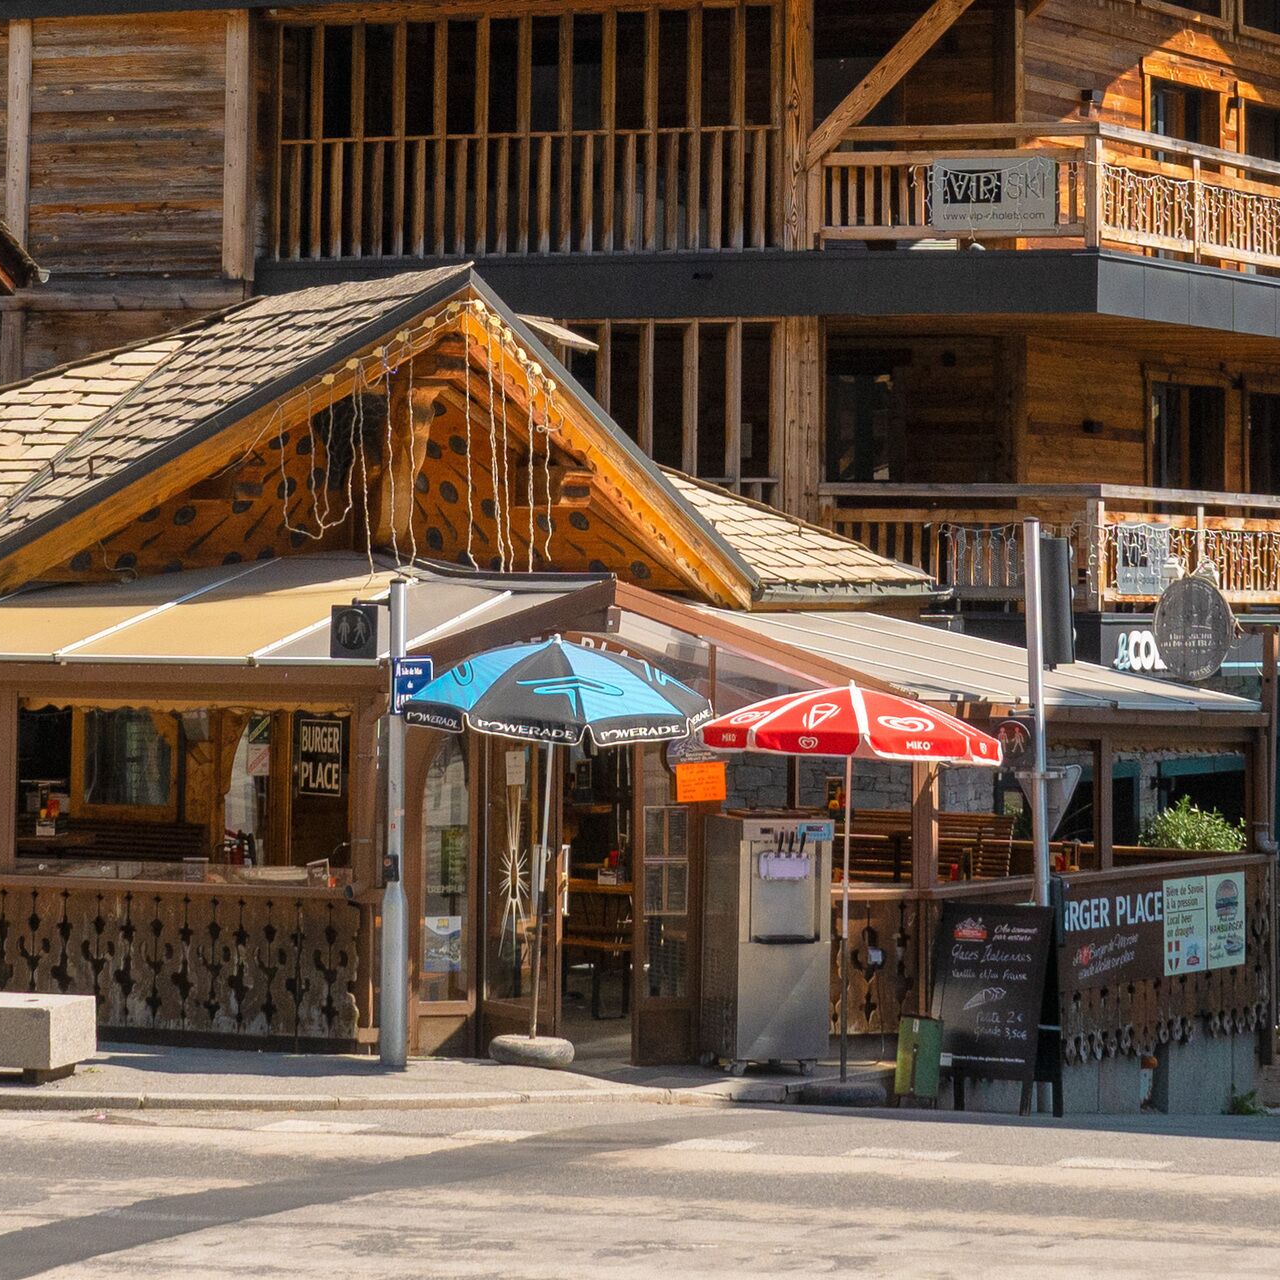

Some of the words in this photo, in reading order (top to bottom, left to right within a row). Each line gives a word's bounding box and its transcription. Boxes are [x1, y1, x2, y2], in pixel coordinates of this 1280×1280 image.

[1007, 172, 1045, 199] SKI
[301, 726, 340, 753] BURGER
[905, 741, 931, 750] MIKO
[301, 761, 339, 790] PLACE
[1116, 891, 1163, 926] PLACE
